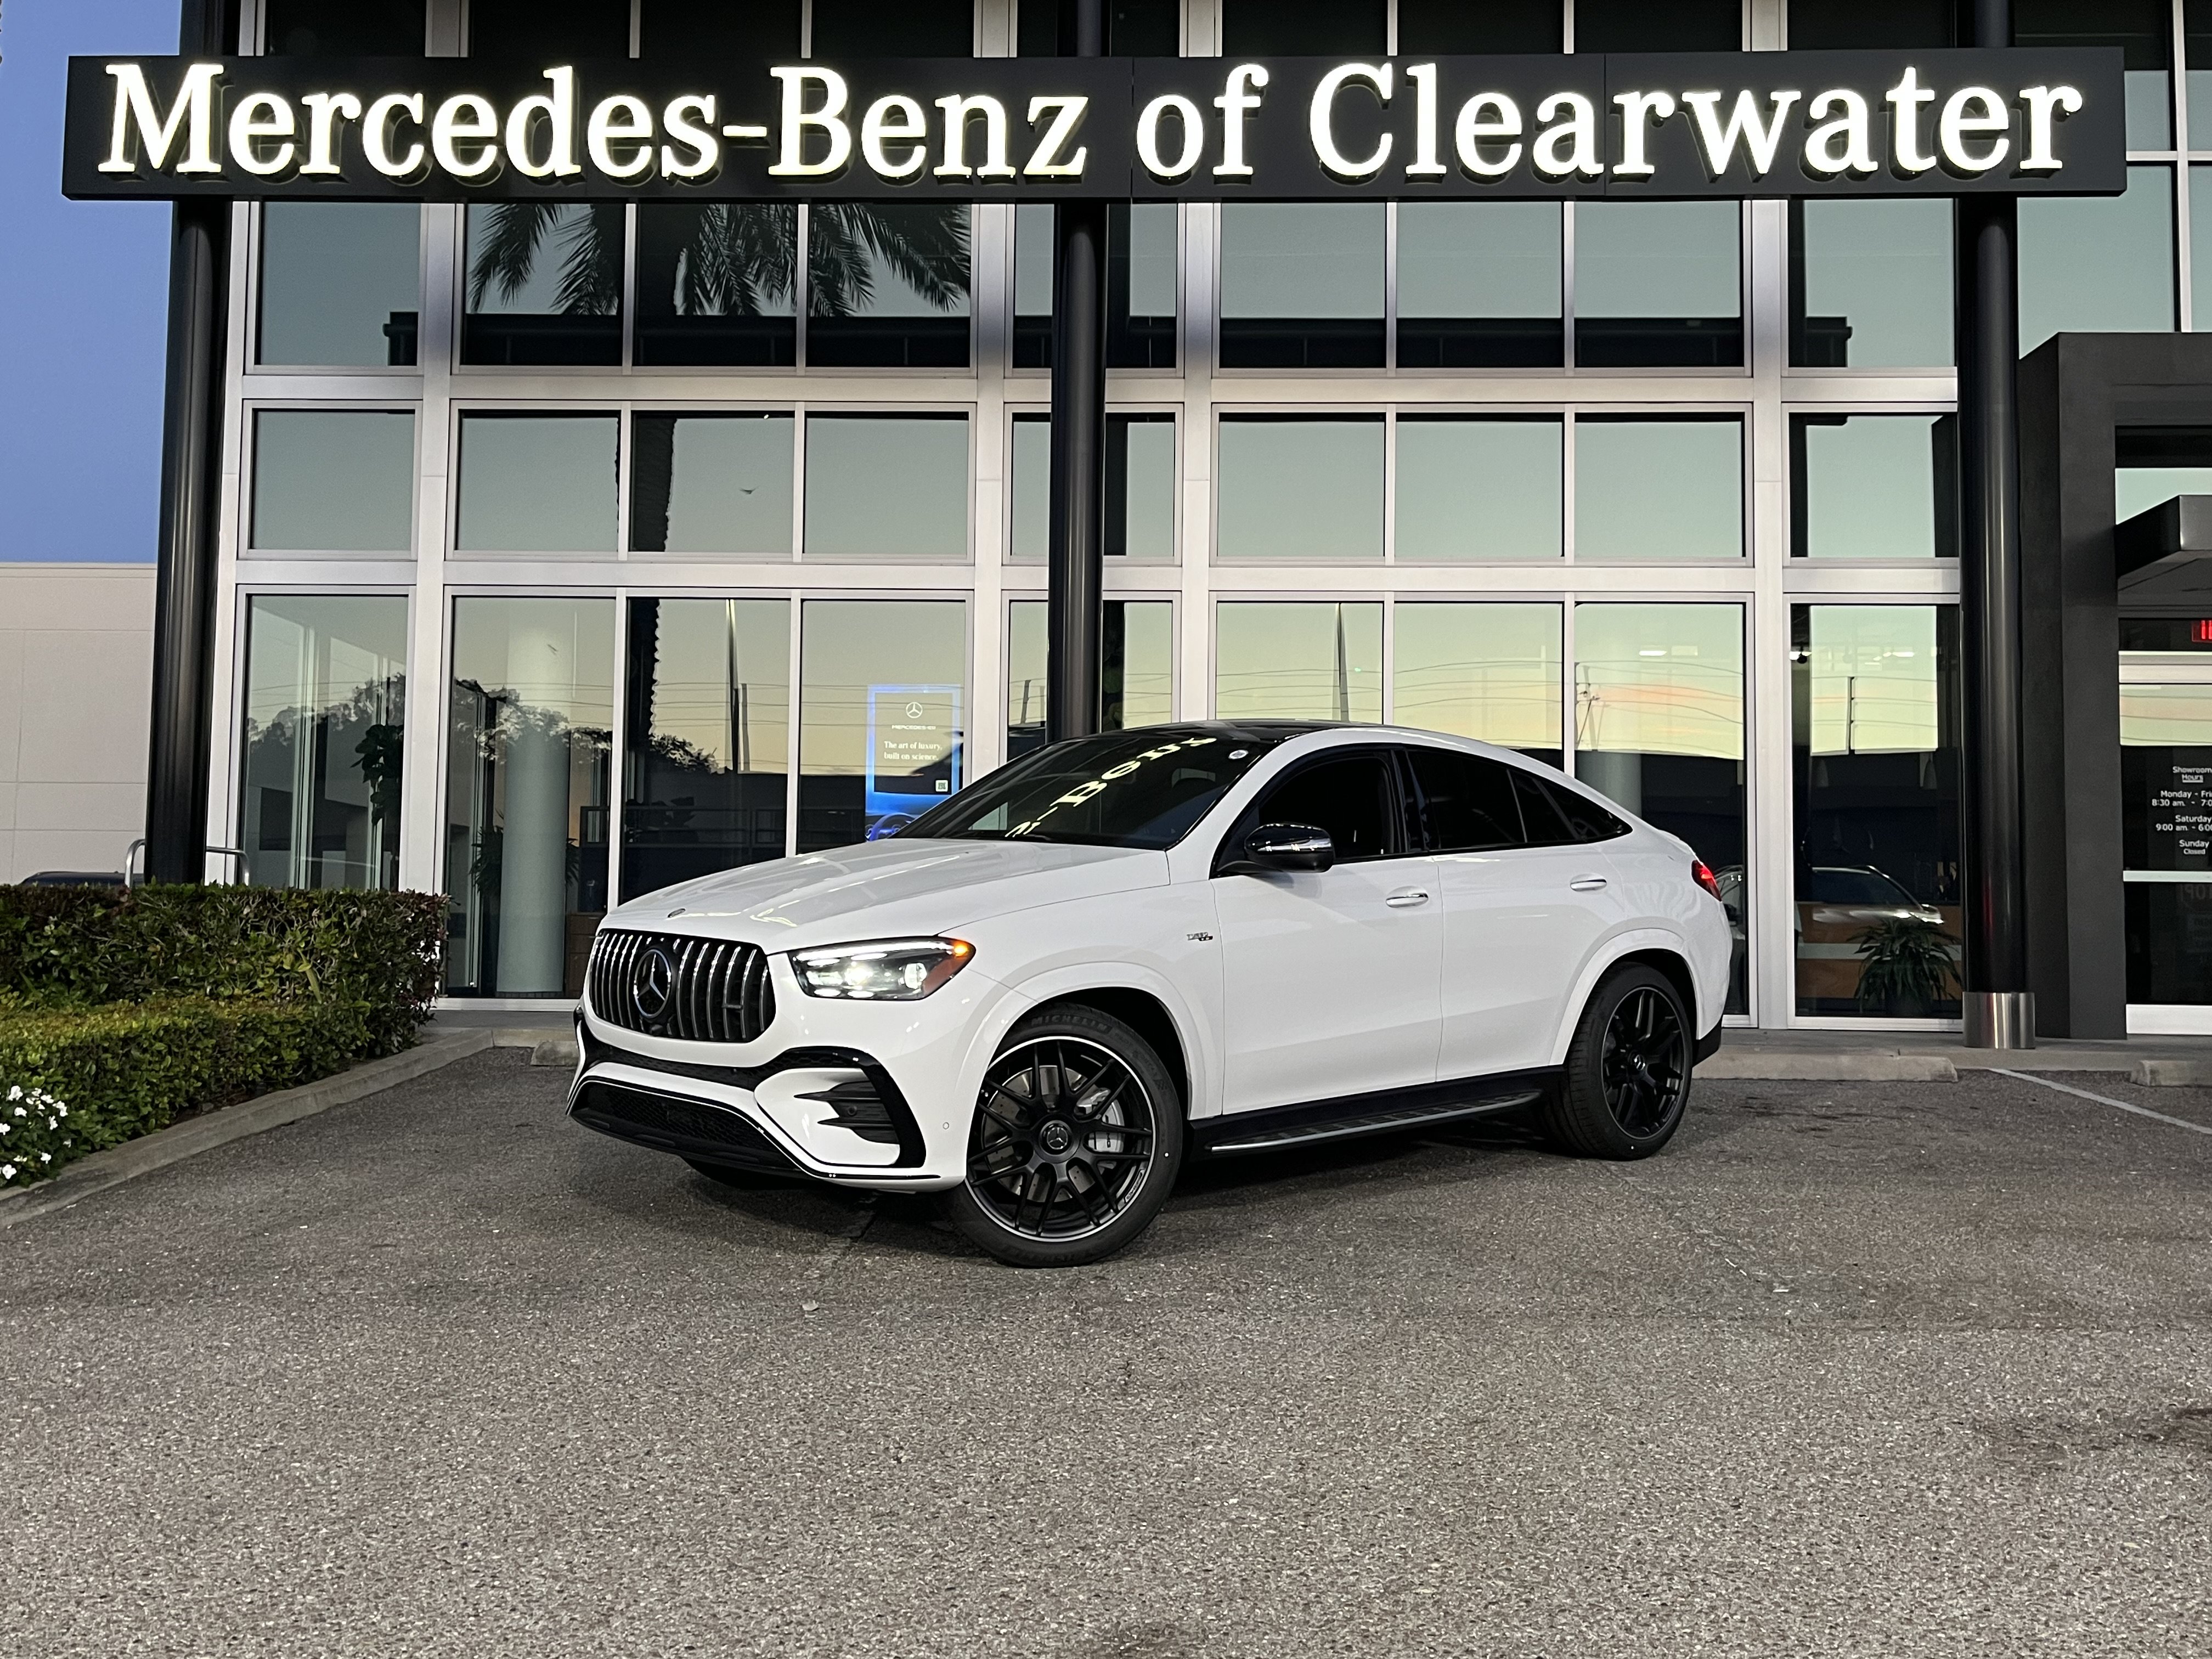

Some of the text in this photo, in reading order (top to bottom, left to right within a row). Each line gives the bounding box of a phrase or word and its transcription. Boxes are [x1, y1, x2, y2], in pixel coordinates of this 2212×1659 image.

[98, 62, 2083, 178] Mercedes-Benz of Clearwater
[884, 741, 897, 749] The
[884, 752, 900, 760] built
[2182, 774, 2203, 783] Hours
[2160, 790, 2192, 799] Monday
[2175, 815, 2212, 823] Saturday
[2179, 839, 2209, 849] Sunday
[1031, 1015, 1108, 1032] MICHELIN
